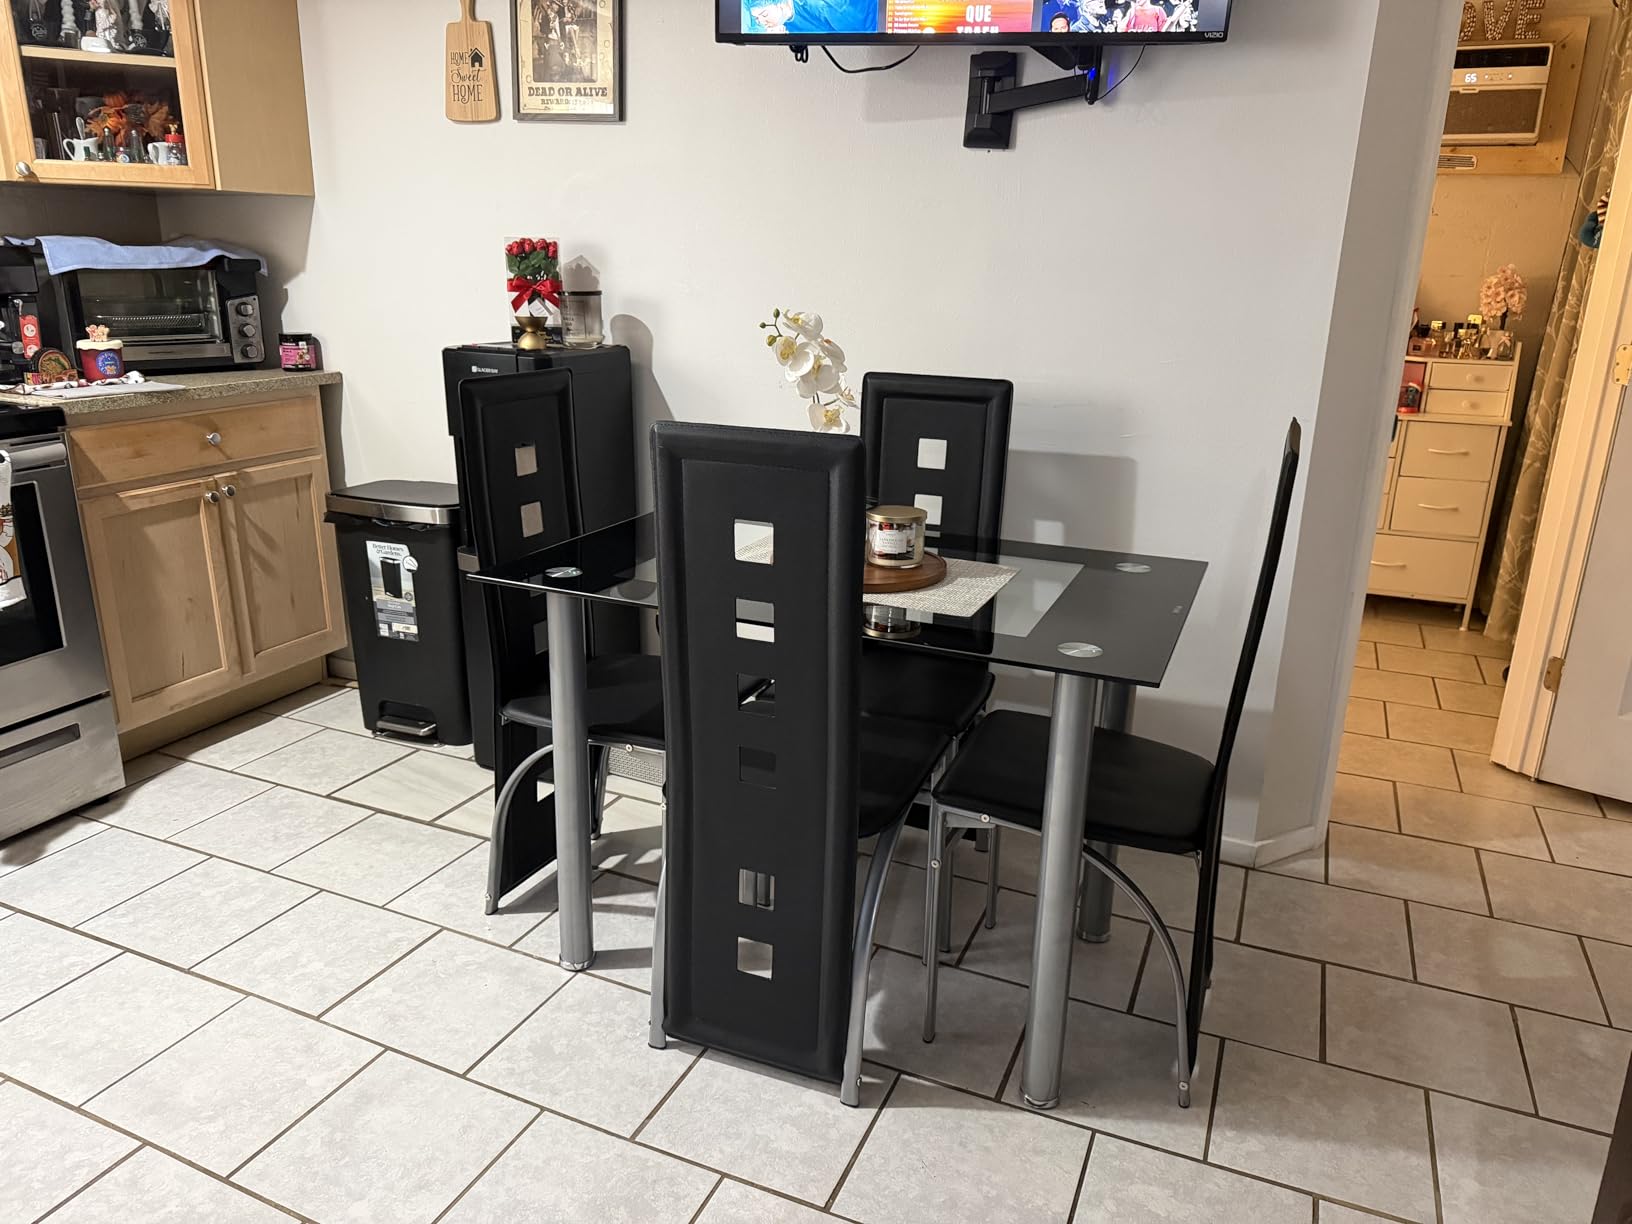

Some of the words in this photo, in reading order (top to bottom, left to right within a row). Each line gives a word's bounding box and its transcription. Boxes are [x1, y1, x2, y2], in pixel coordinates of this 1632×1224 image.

[965, 5, 992, 23] QUE
[1204, 31, 1224, 39] VIZIO
[450, 51, 469, 66] HOME
[450, 67, 487, 83] Sweet
[1464, 73, 1478, 83] 65
[452, 85, 483, 104] HOME
[528, 87, 555, 97] DEAD
[557, 87, 573, 97] OR
[575, 87, 608, 97] ALIVE
